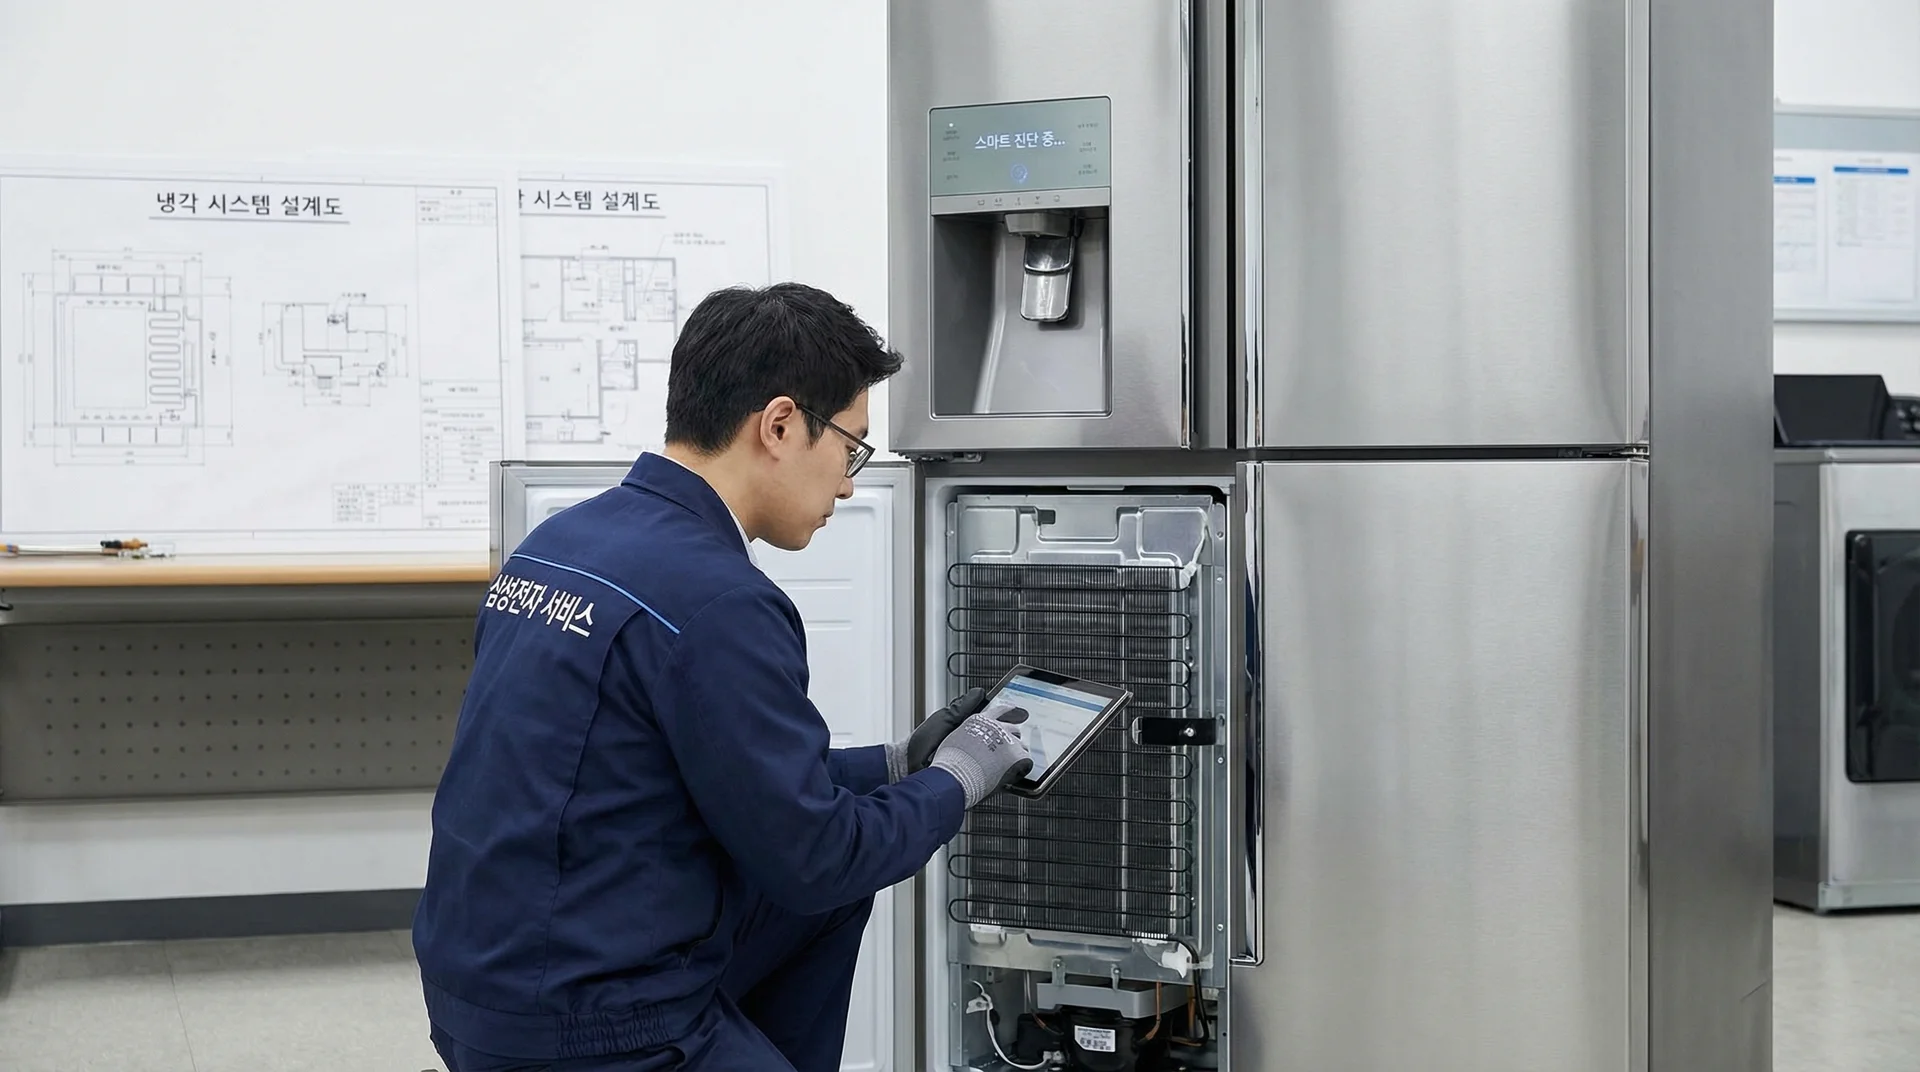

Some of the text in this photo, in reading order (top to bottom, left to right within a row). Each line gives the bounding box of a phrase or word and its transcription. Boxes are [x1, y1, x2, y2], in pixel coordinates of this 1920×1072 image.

[975, 134, 1011, 149] 스마트
[1014, 132, 1039, 148] 진단
[1042, 131, 1066, 147] 중...
[156, 192, 343, 217] 냉각 시스템 설계도
[534, 189, 592, 211] 시스템
[602, 191, 660, 211] 설계도
[485, 573, 595, 638] 삼성전자 서비스
